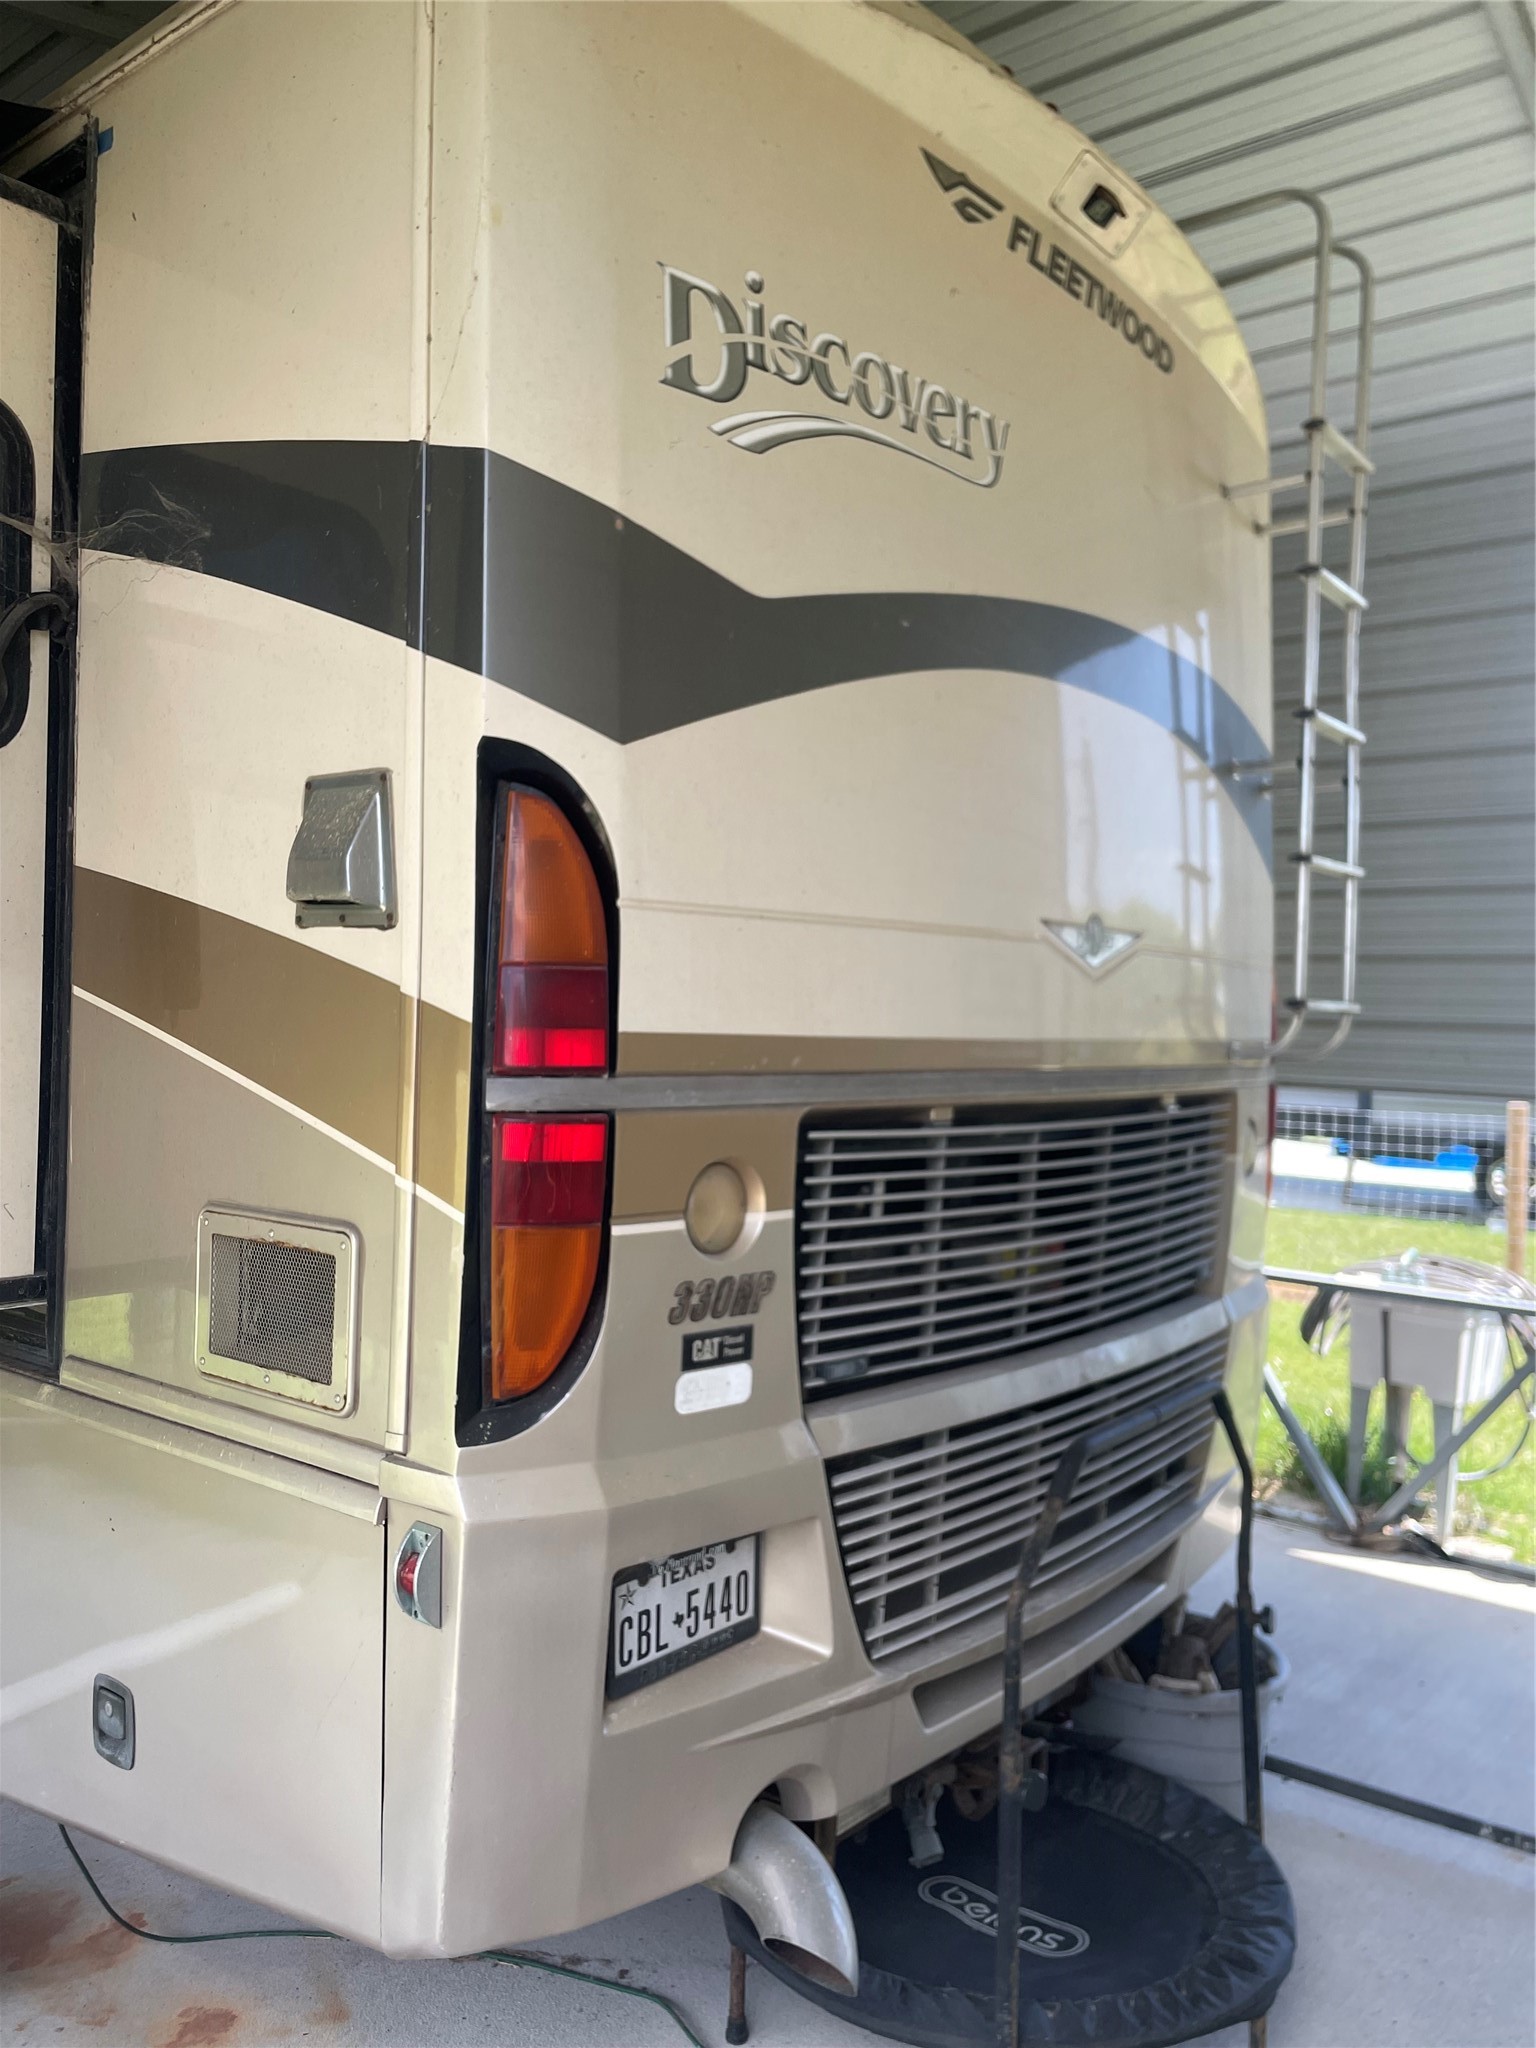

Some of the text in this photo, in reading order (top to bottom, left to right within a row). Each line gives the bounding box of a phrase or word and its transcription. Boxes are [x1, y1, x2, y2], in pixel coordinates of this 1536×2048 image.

[1006, 215, 1175, 374] FLEETWOOD
[656, 260, 1010, 488] Discovery
[668, 1270, 777, 1326] 330HP
[691, 1337, 722, 1362] CAT
[660, 1555, 717, 1588] TEXAS
[619, 1603, 669, 1668] CBL
[685, 1569, 749, 1638] 5440
